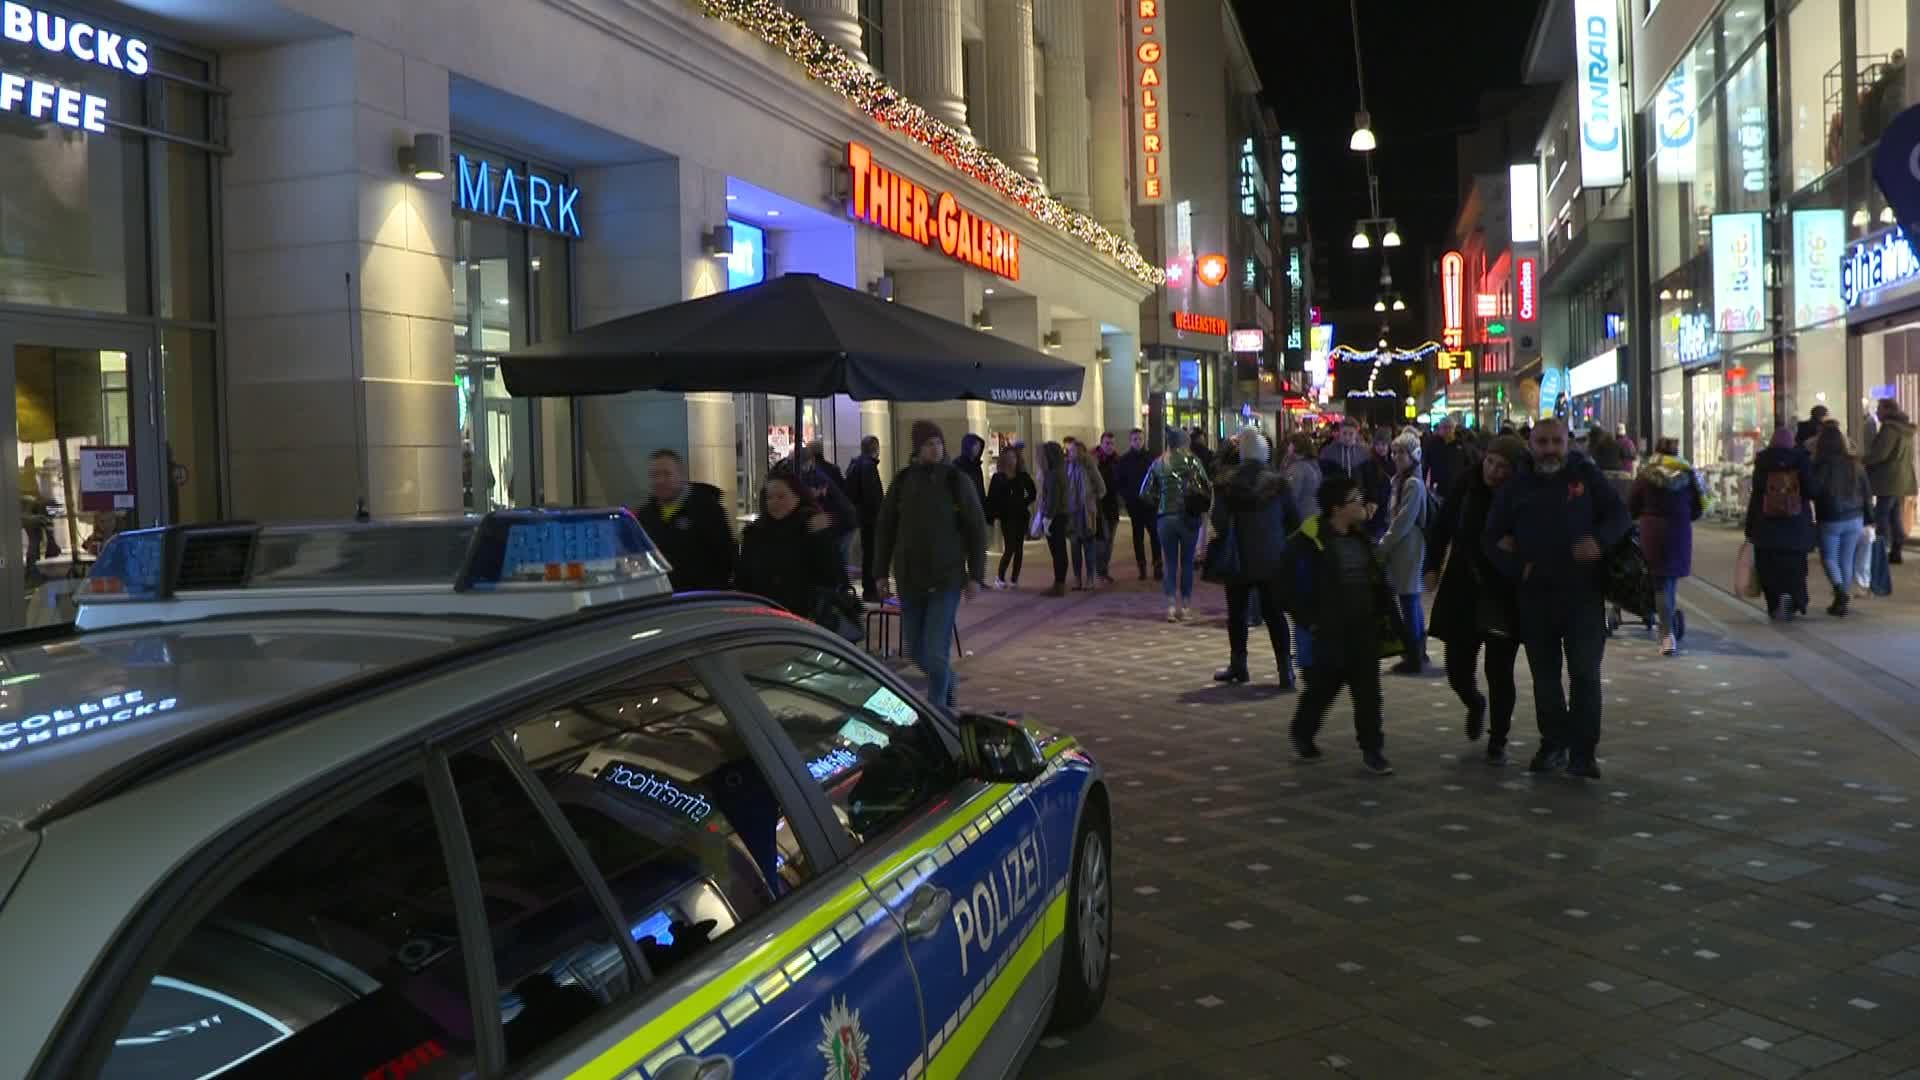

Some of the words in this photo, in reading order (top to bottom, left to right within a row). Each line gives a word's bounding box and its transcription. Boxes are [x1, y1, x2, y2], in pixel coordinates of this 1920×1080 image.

[2, 0, 150, 76] BUCKS
[1583, 15, 1619, 151] CONRAD
[457, 153, 582, 238] MARK
[848, 139, 1020, 282] THIER-GALERIE
[991, 388, 1042, 401] STARBUCKS
[952, 831, 1042, 977] POLIZEI
